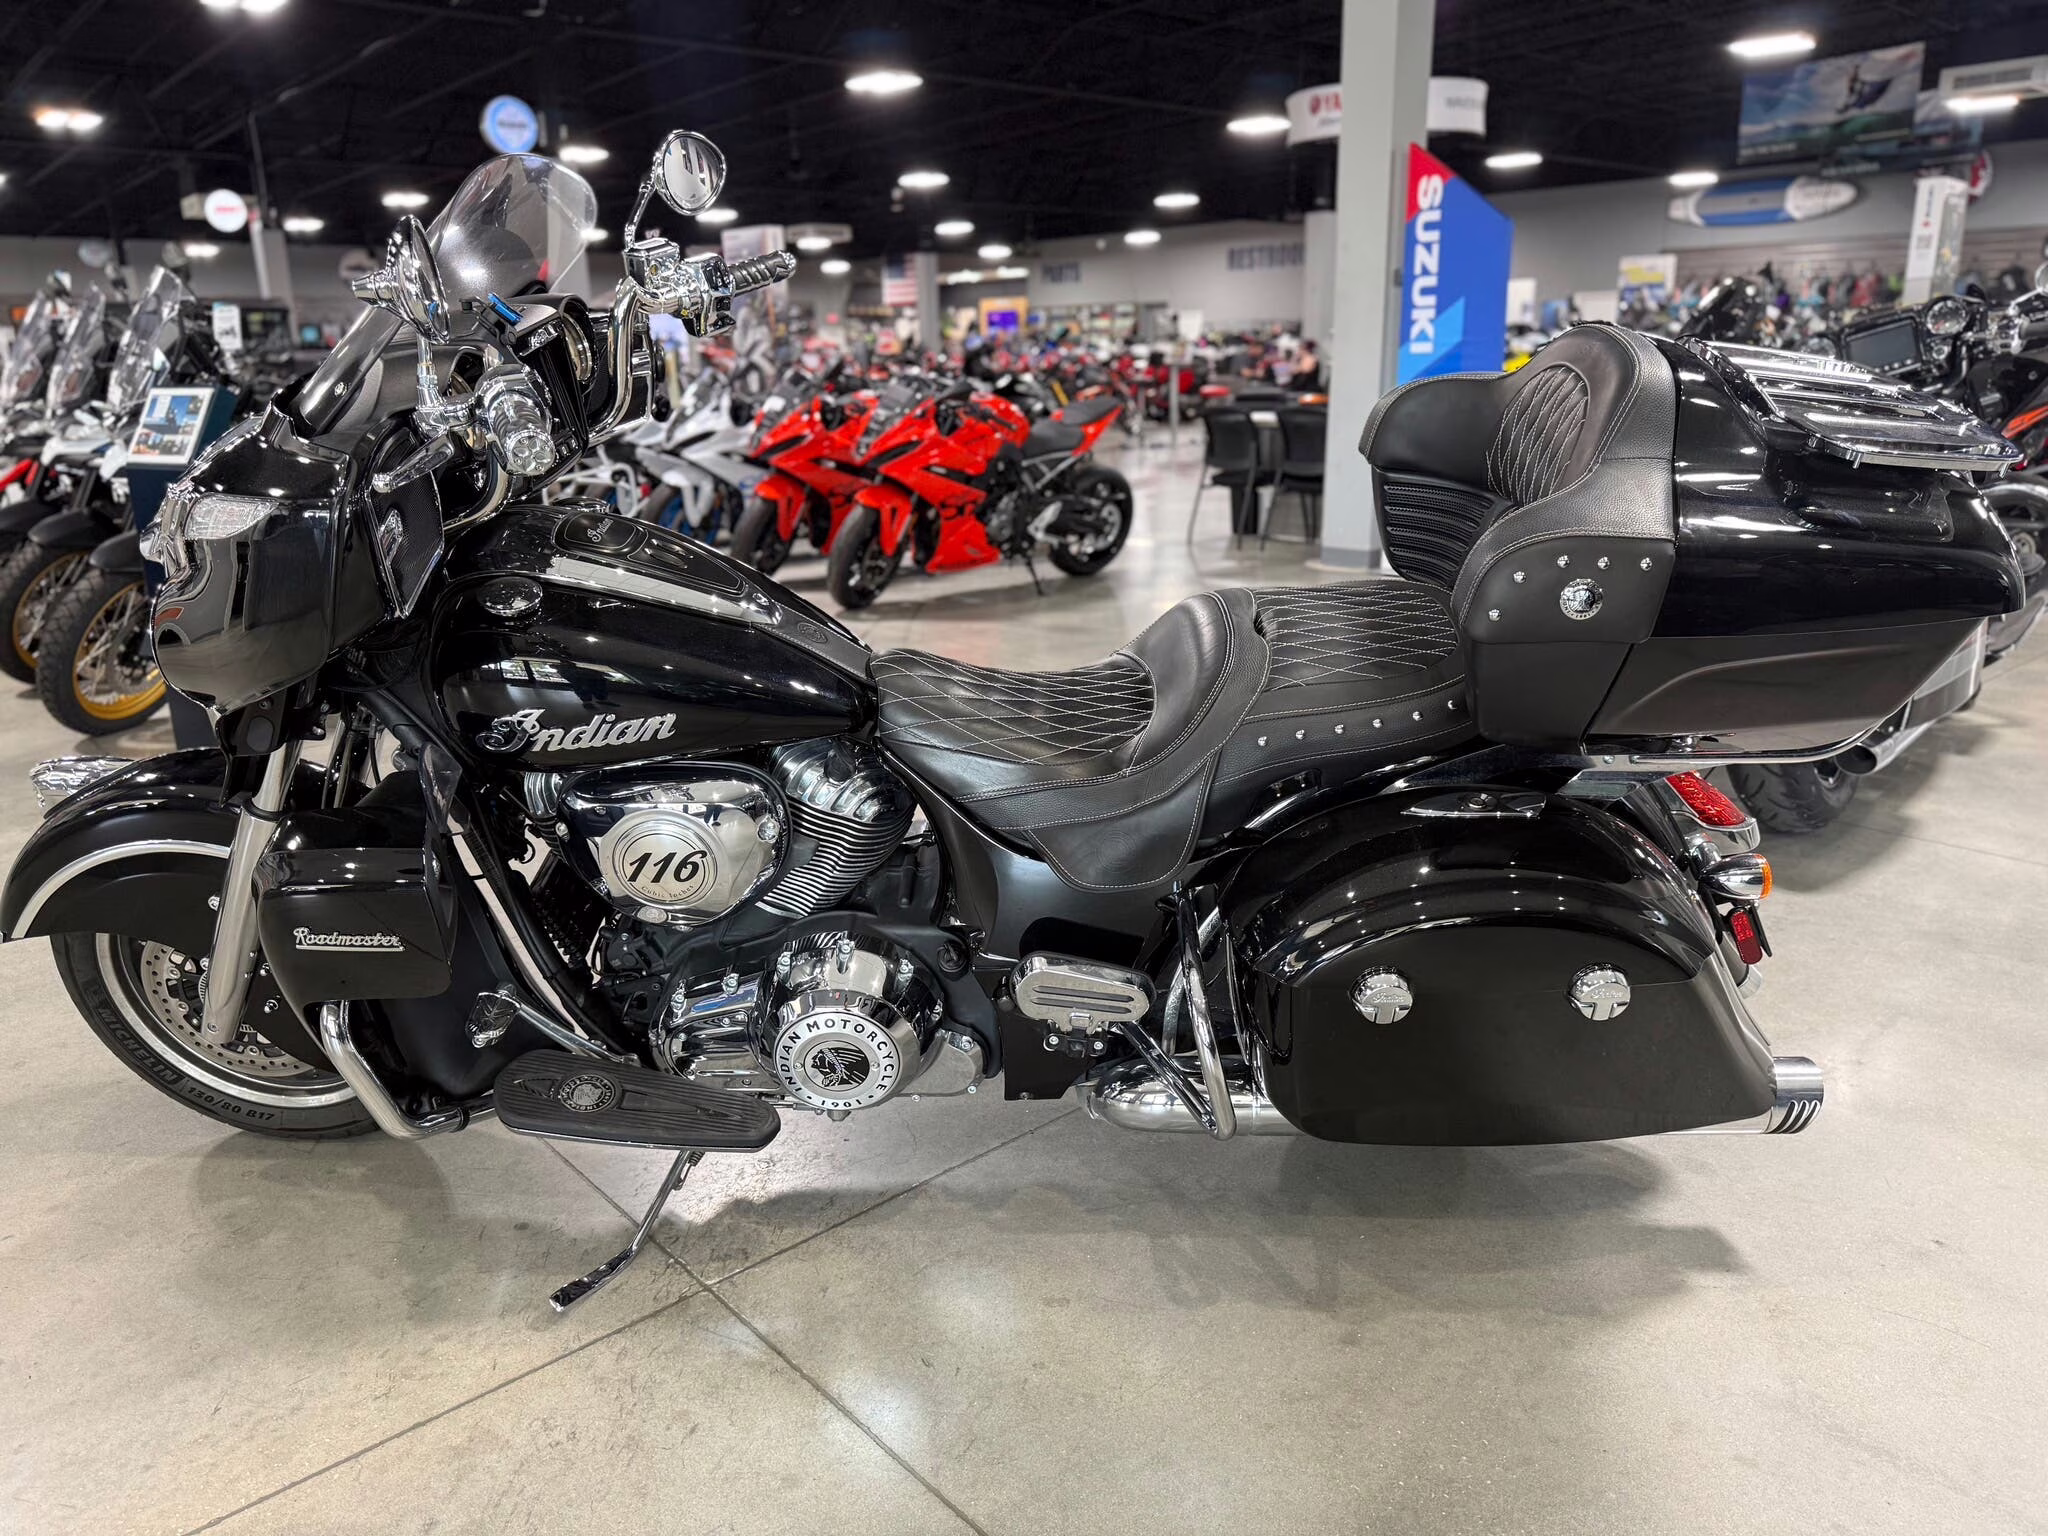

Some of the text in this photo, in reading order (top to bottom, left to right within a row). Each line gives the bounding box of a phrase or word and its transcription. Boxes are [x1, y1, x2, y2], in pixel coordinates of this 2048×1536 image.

[1409, 173, 1445, 355] SUZUKI
[475, 708, 677, 752] Indian
[626, 849, 708, 884] 116
[641, 884, 694, 899] Cubic Inches
[293, 926, 402, 948] Roadmaster
[98, 1007, 178, 1083] MICHELIN
[780, 1018, 895, 1092] INDIAN MOTORCYCLE
[187, 1086, 275, 1121] 130/80 B17
[820, 1098, 863, 1108] 1901
